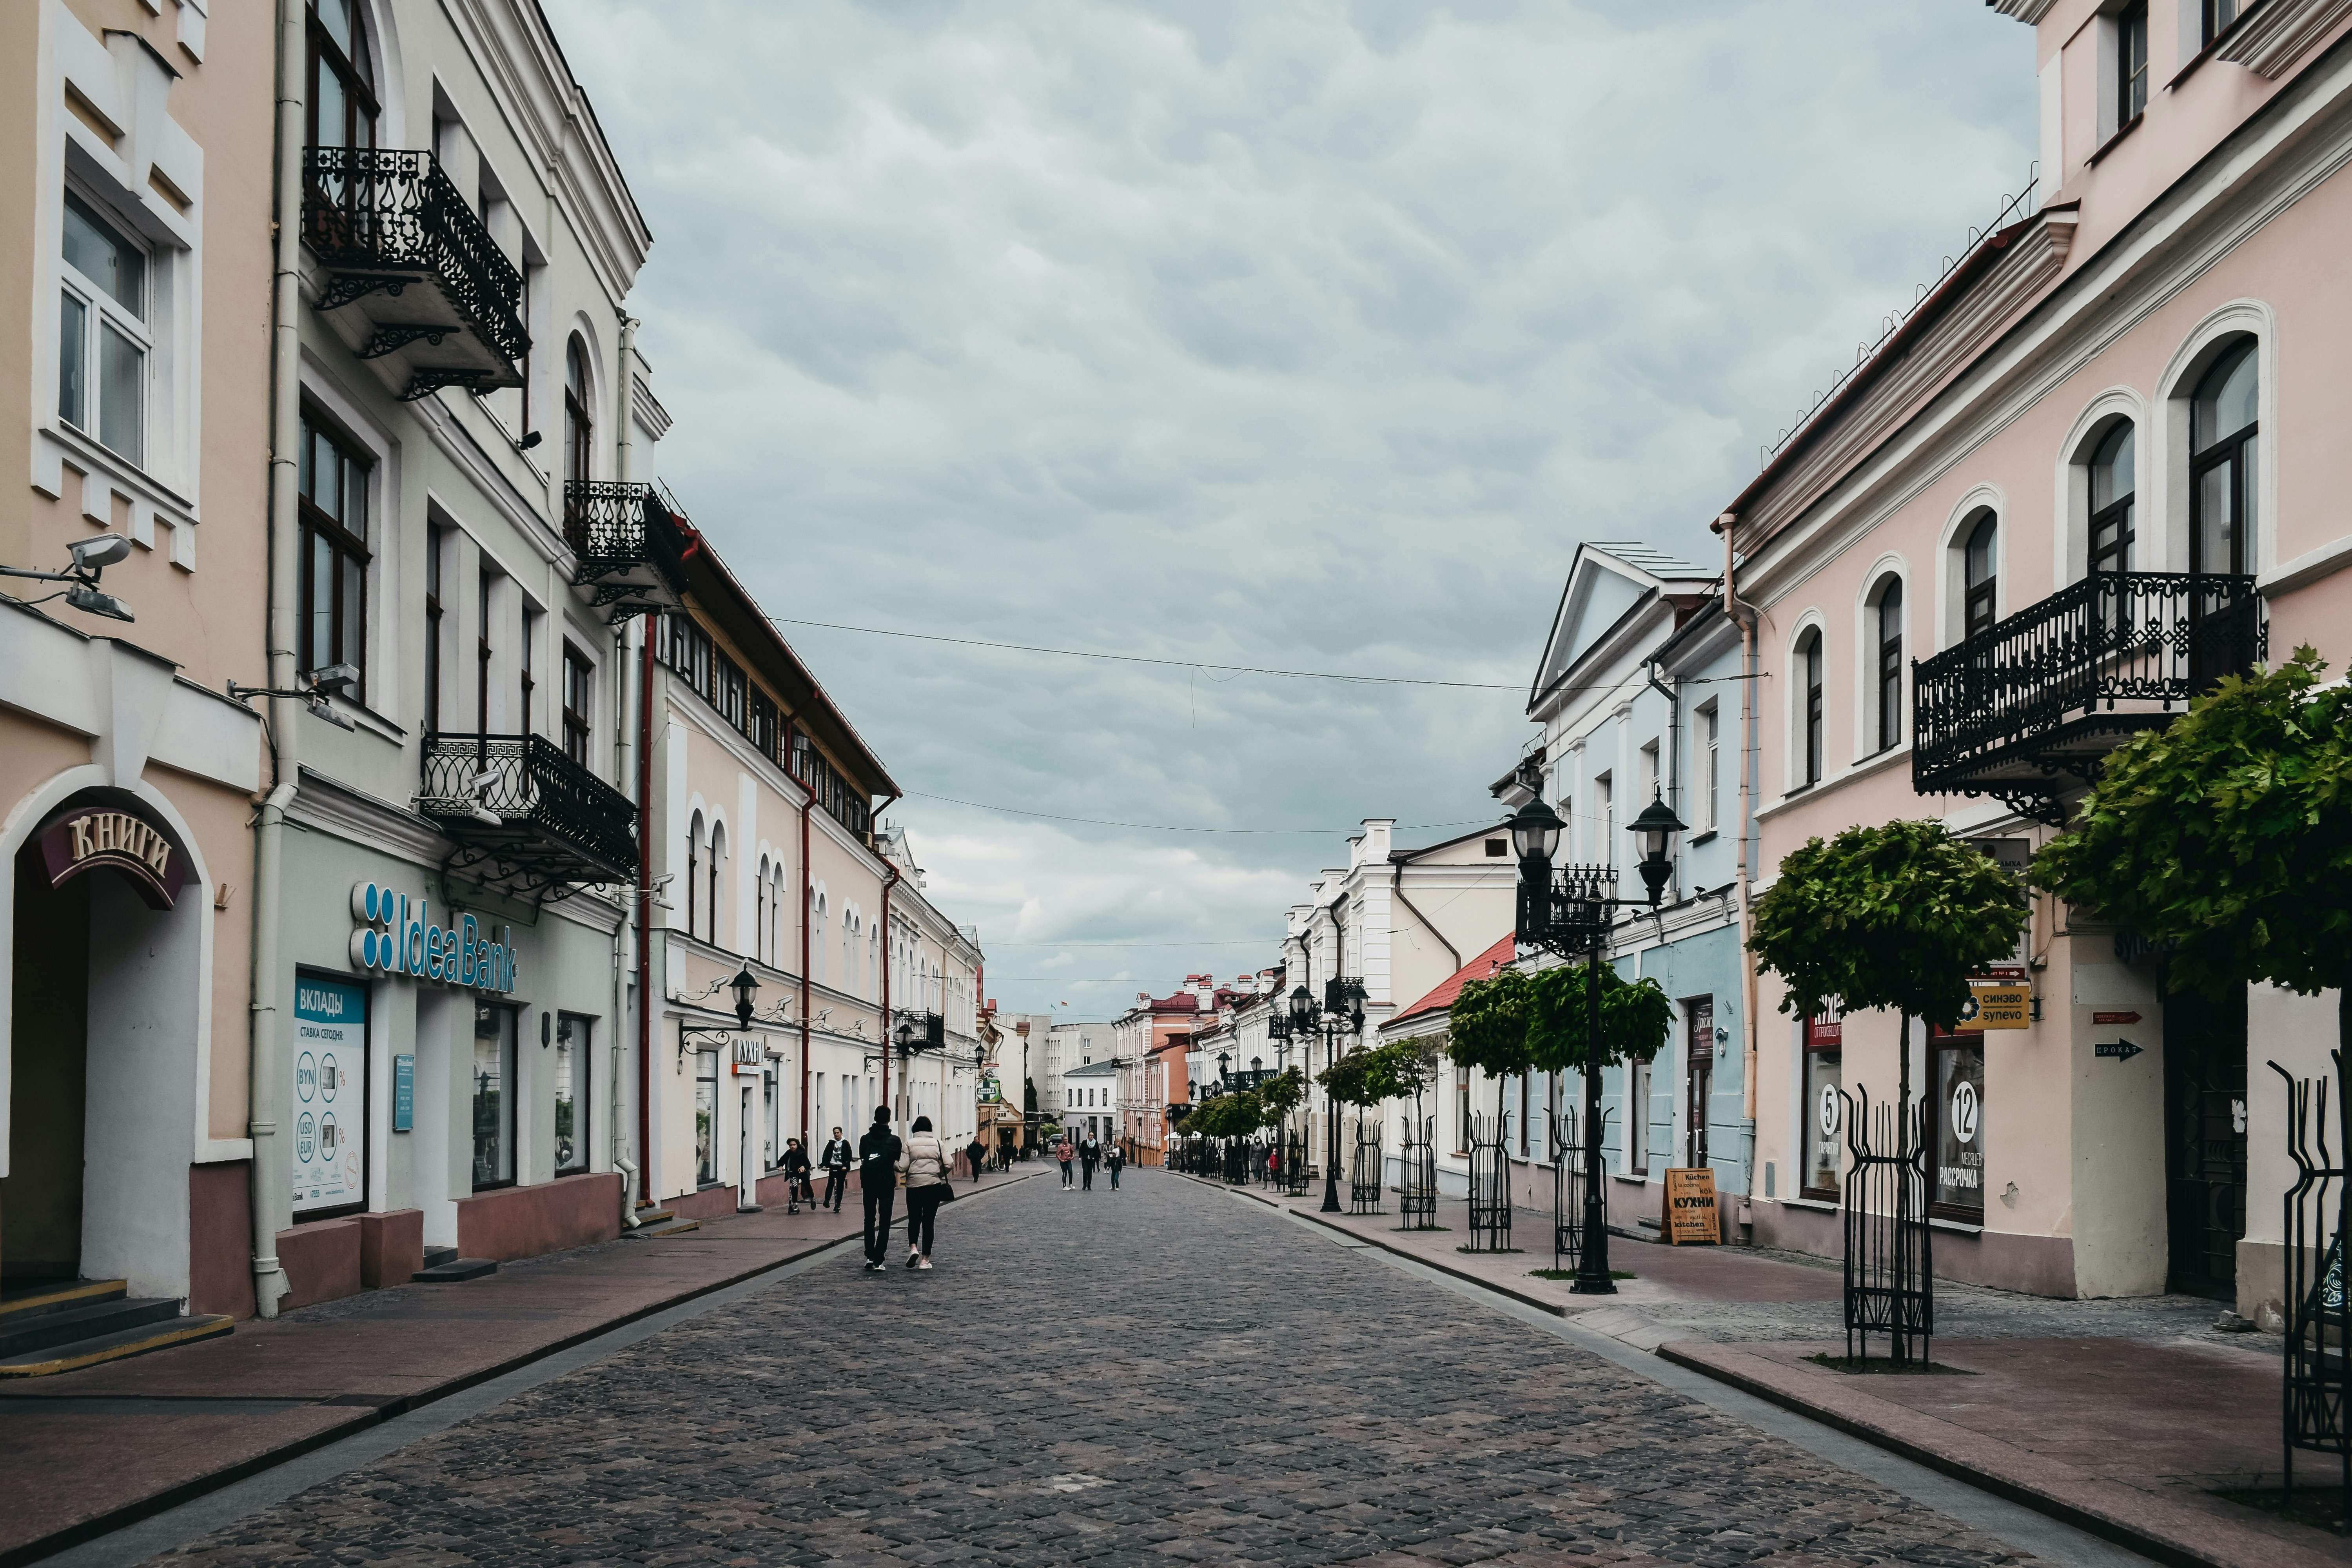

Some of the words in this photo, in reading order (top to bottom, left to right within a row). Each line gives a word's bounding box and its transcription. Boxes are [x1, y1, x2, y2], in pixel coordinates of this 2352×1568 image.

[69, 813, 172, 878] КНИГИ
[300, 988, 343, 1017] ВКЛАДЫ
[1983, 995, 2022, 1003] СИНЭВО
[1983, 1011, 2022, 1022] synevo
[300, 1026, 320, 1038] СТАВКА
[321, 1029, 344, 1041] СЕГОДНЯ:
[738, 1040, 764, 1063] КУХНИ
[299, 1069, 314, 1084] BYN
[1826, 1091, 1832, 1129] 5
[1956, 1088, 1973, 1134] 12
[300, 1122, 312, 1134] USD
[300, 1141, 312, 1154] EUR
[1818, 1141, 1838, 1155] ГАРАНТИЯ
[1961, 1152, 1982, 1167] МЕСЯЦЕВ
[1940, 1167, 1977, 1189] РАССРОЧКА
[1673, 1197, 1714, 1208] КУХНИ
